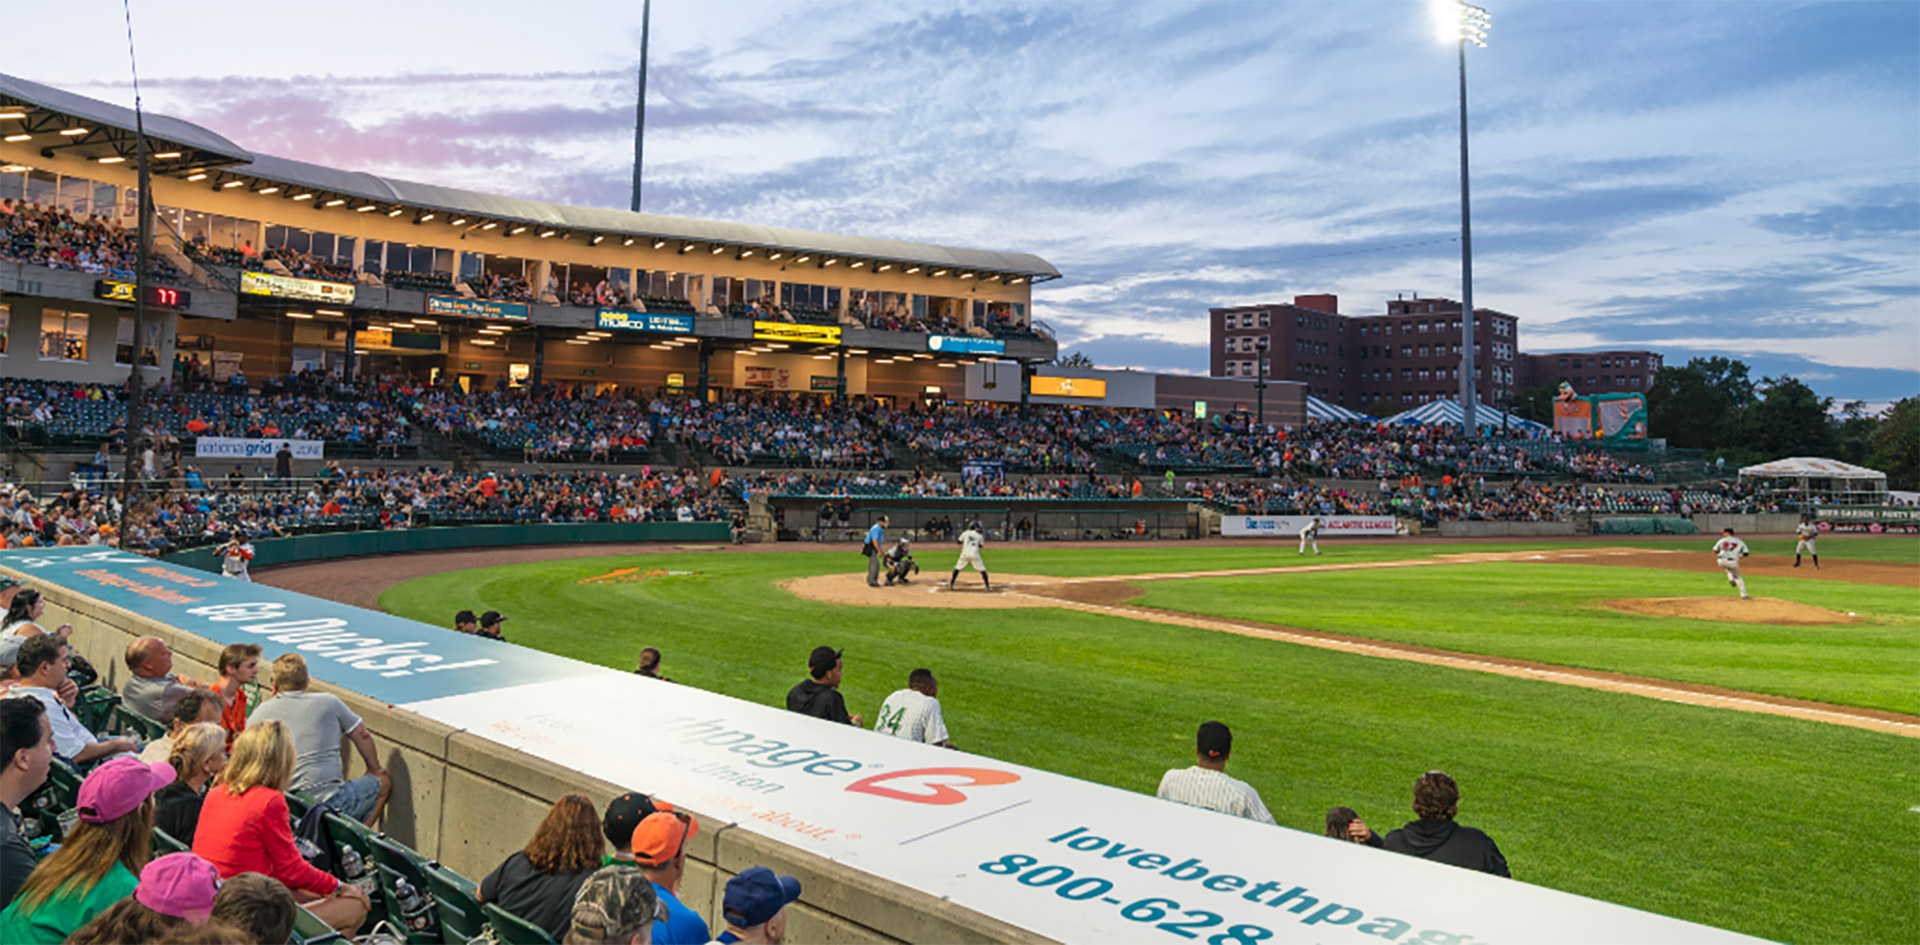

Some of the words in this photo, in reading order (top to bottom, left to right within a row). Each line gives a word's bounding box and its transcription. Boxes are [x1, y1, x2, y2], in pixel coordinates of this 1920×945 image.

[1328, 520, 1363, 529] ATLANTIC
[1365, 520, 1393, 529] LEAGUE
[186, 602, 287, 622] Go
[238, 617, 499, 678] Ducks!
[877, 703, 907, 736] 34
[691, 761, 785, 794] Union
[752, 808, 836, 842] about.
[1047, 826, 1488, 945] lovebethpag
